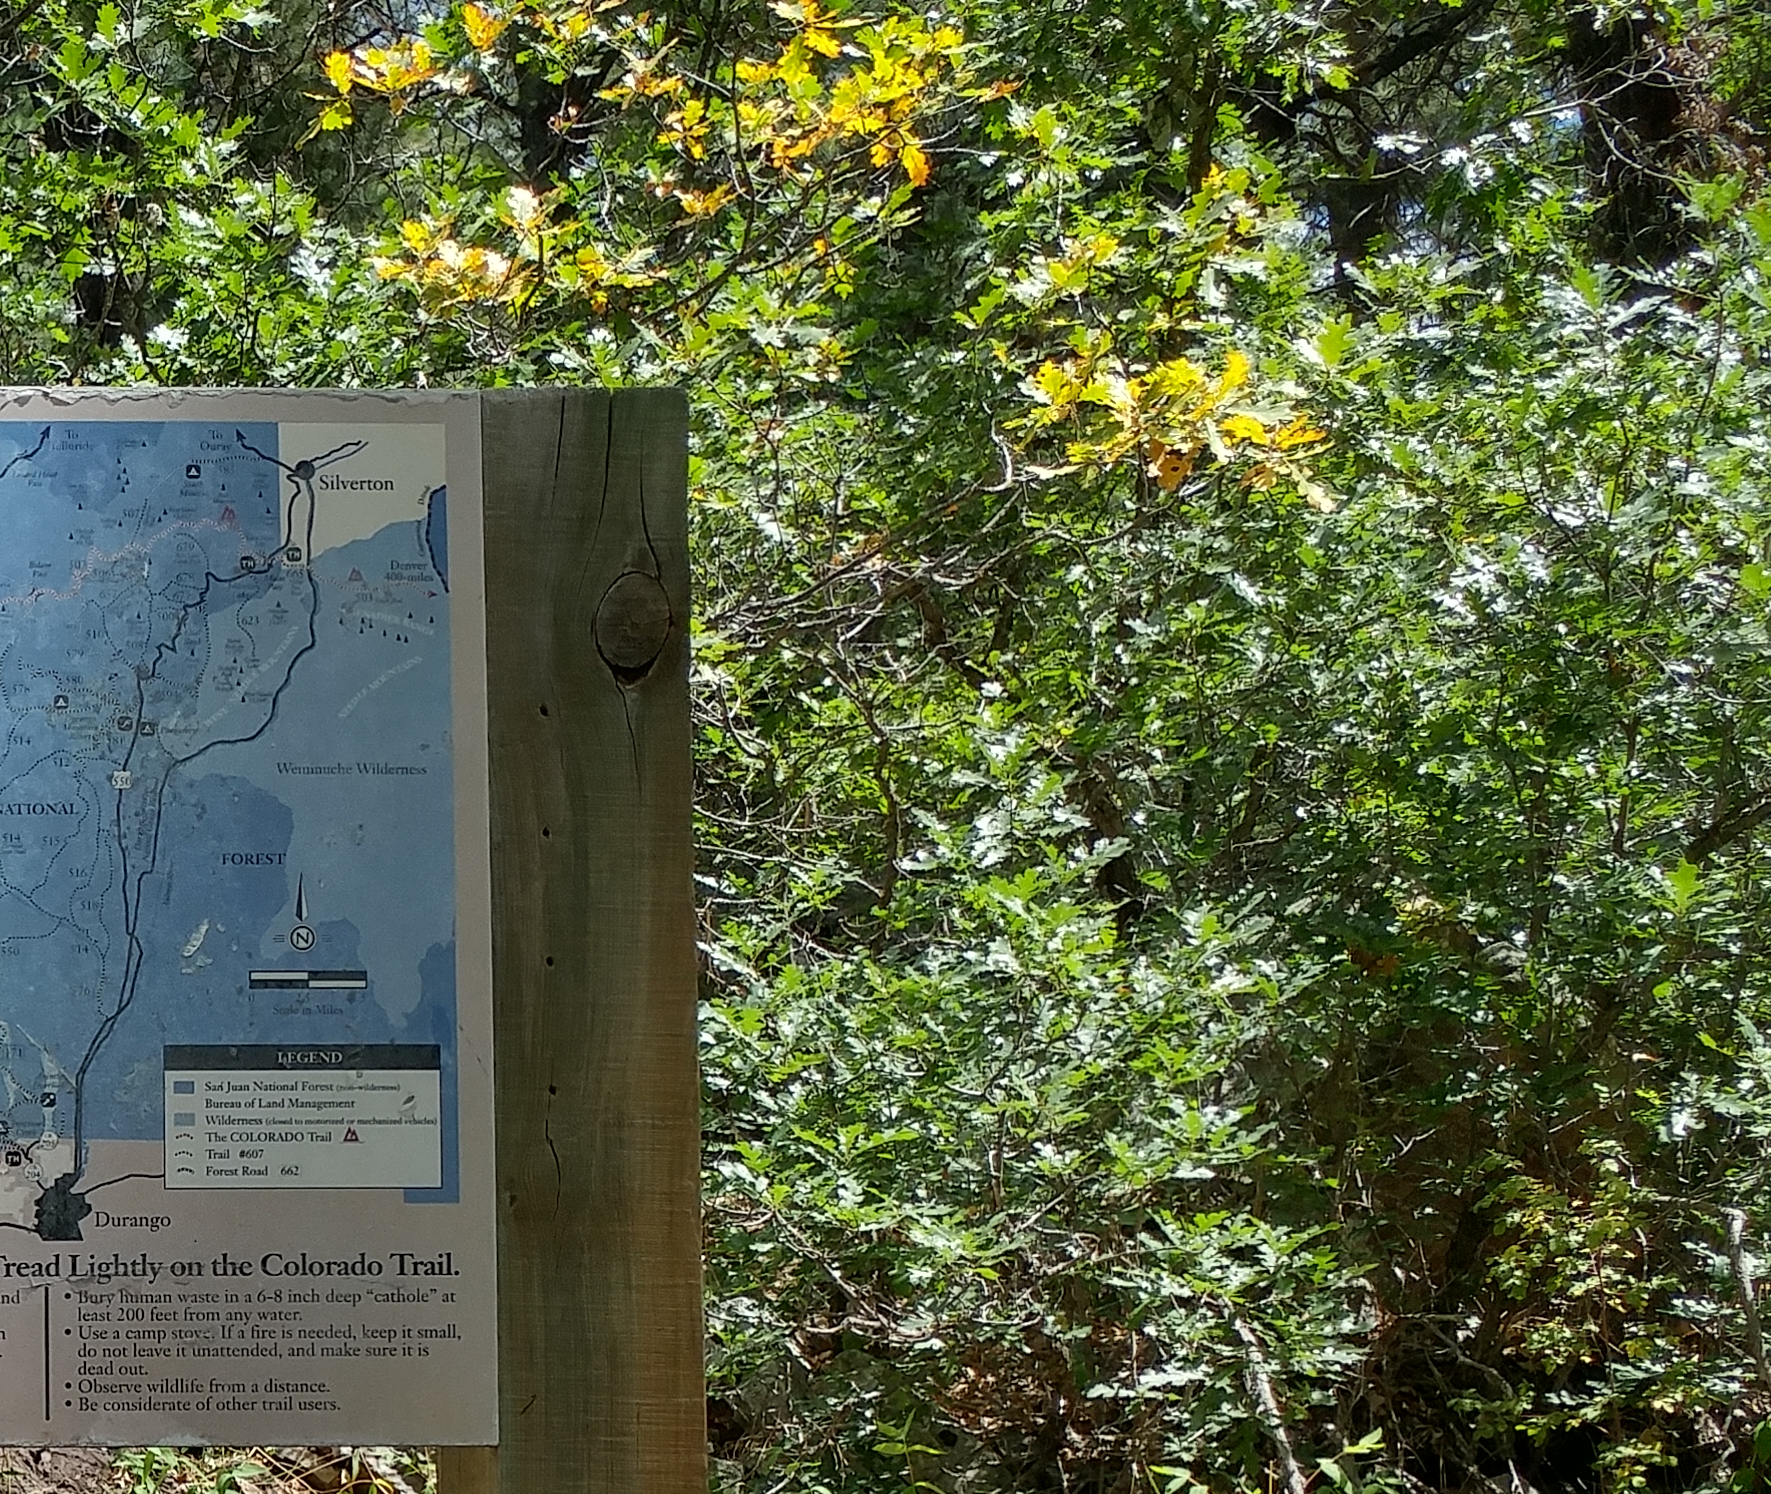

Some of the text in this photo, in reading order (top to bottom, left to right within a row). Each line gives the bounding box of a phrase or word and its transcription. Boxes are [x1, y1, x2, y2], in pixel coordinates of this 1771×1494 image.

[319, 475, 394, 491] Silverton
[277, 762, 427, 776] Weminuche Wilderness
[113, 775, 132, 787] 550
[222, 853, 287, 865] FOREST
[277, 1052, 342, 1064] LEGEND
[205, 1098, 355, 1112] Bureau of Land Management
[205, 1132, 332, 1143] The COLORADO Trail
[94, 1211, 171, 1232] Durango
[69, 1255, 163, 1284] Lightly
[170, 1260, 203, 1277] on
[211, 1253, 253, 1277] the
[261, 1253, 383, 1277] Colorado
[390, 1253, 460, 1277] Trail.
[79, 1397, 340, 1411] Be considerate of other trail users.
